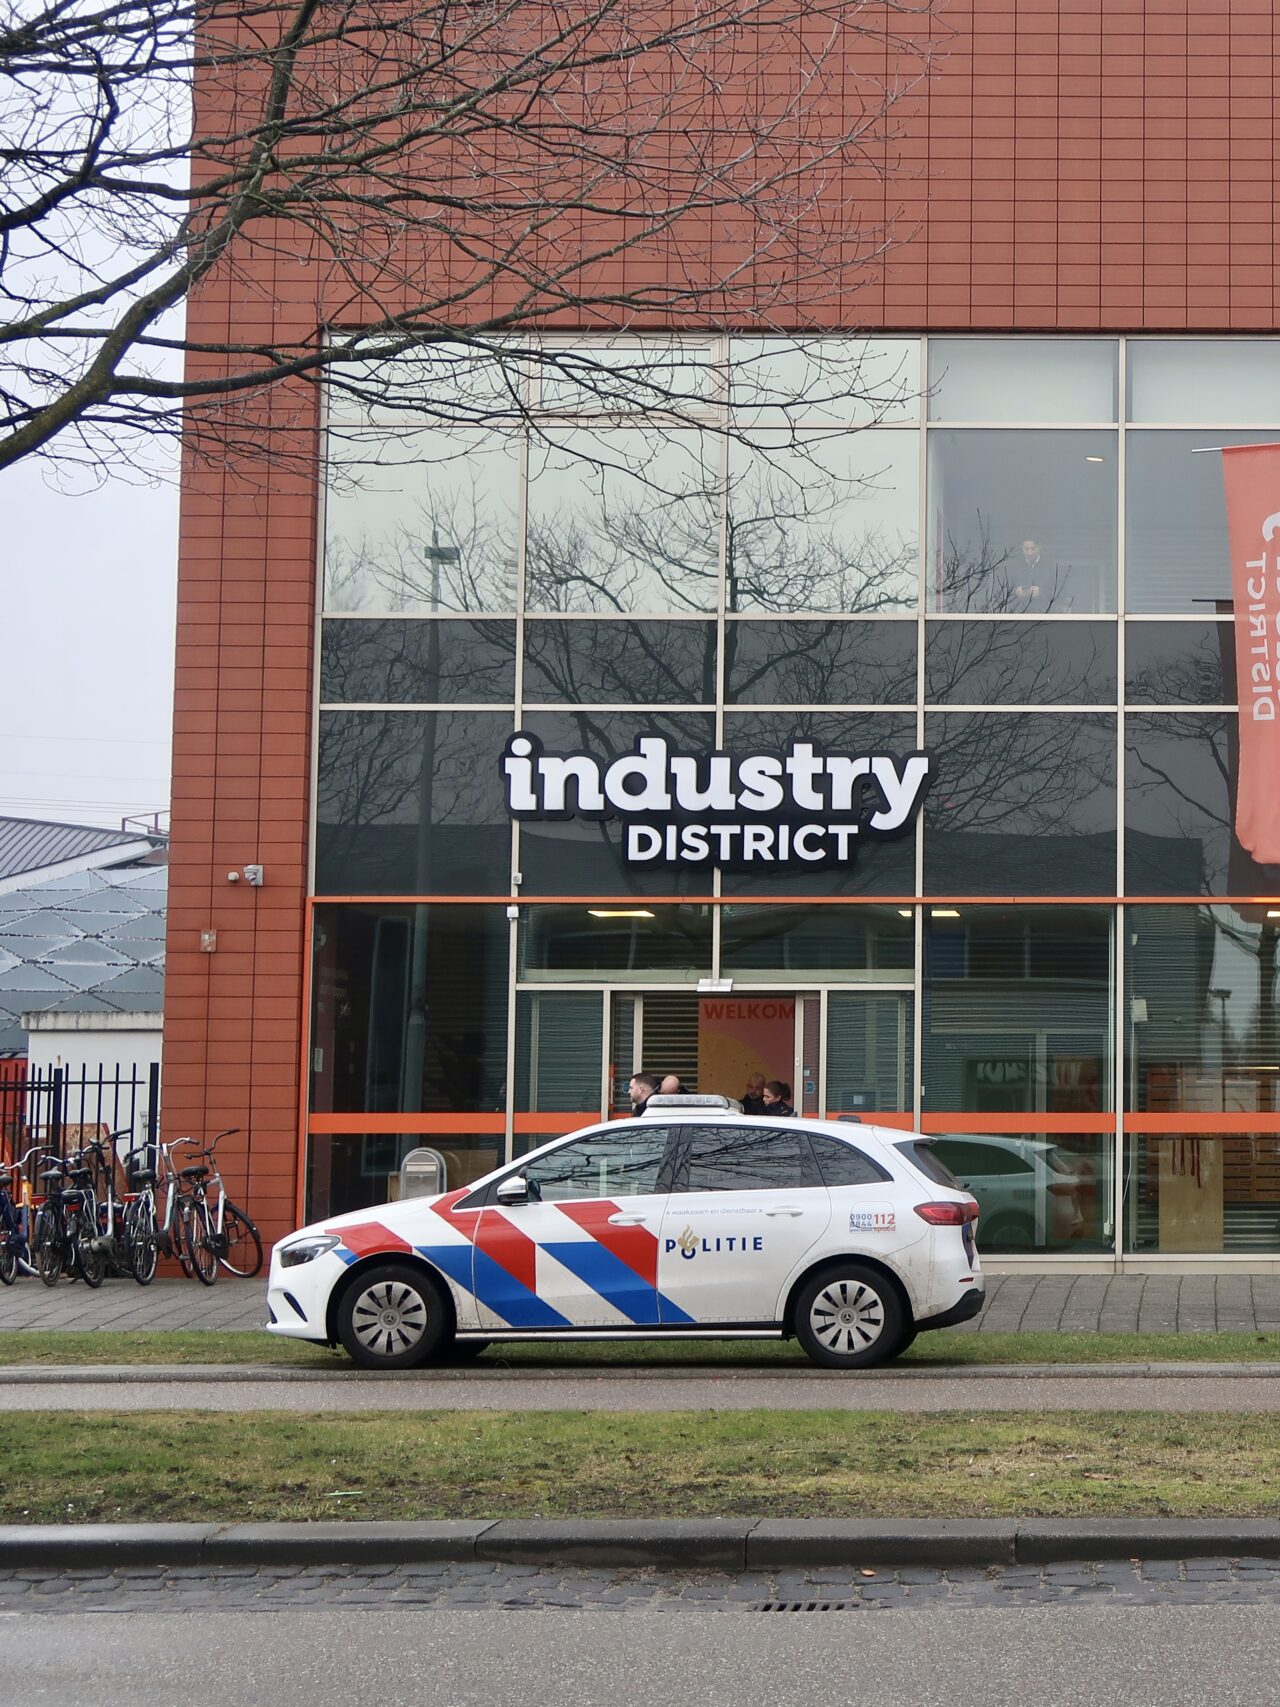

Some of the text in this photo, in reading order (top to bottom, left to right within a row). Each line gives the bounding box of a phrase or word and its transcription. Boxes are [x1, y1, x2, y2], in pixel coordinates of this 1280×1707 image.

[504, 737, 930, 831] industry
[627, 824, 859, 862] DISTRICT
[703, 1003, 795, 1020] WELKOM
[850, 1213, 896, 1225] 0900 112
[665, 1237, 763, 1260] POLITIE
